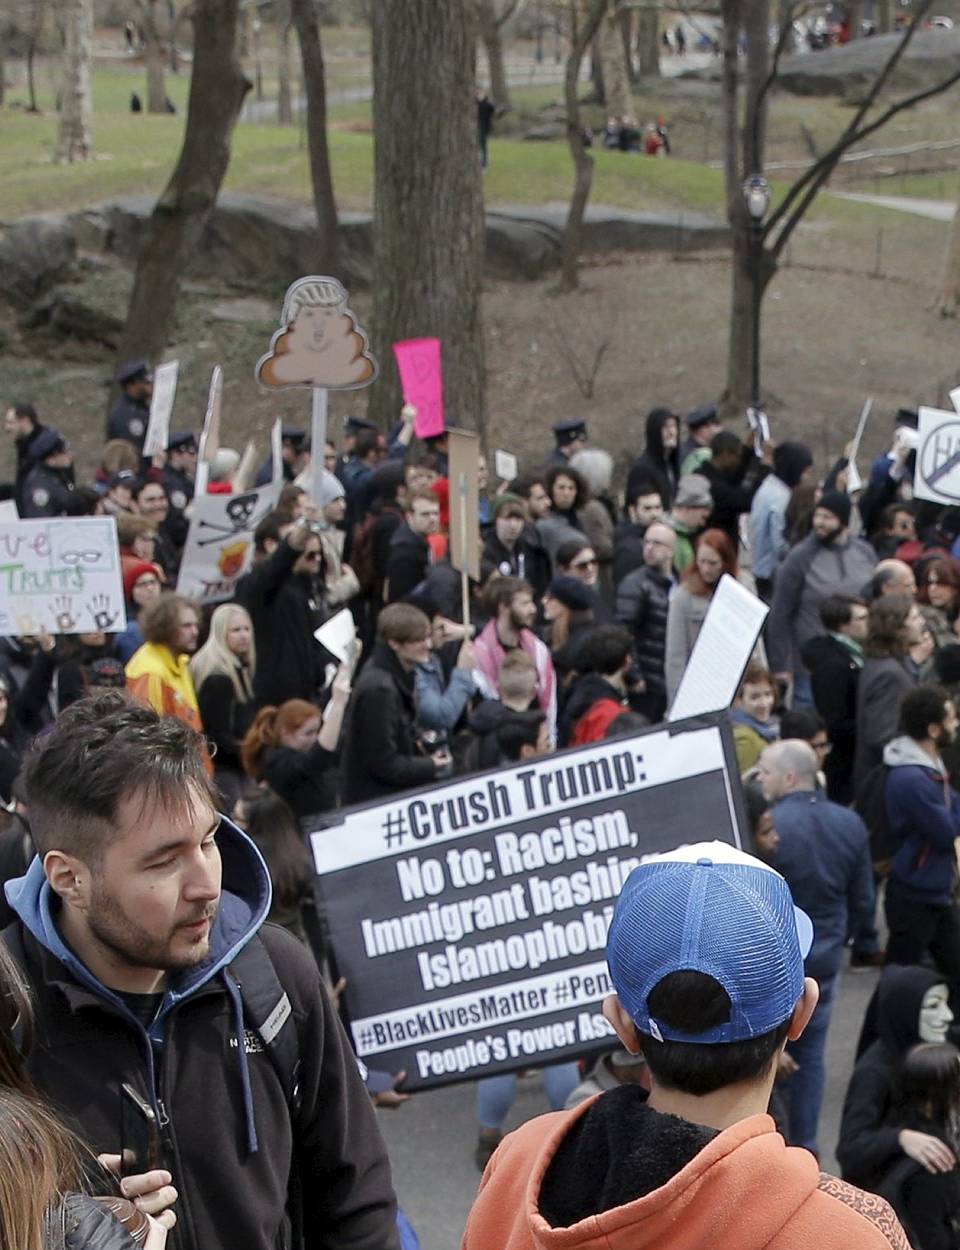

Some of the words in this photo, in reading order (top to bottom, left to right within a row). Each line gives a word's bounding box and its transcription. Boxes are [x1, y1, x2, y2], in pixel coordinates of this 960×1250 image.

[382, 780, 512, 848] #Crush
[516, 751, 647, 810] Trump:
[396, 856, 445, 902] No
[446, 848, 496, 888] to:
[494, 809, 639, 876] Racism,
[361, 881, 530, 958] Immigrant
[417, 904, 614, 991] Islamophobi
[359, 985, 548, 1050] #BlackLivesMatter
[554, 972, 613, 1004] #Pen
[416, 1035, 509, 1078] People's
[507, 1020, 576, 1057] Power
